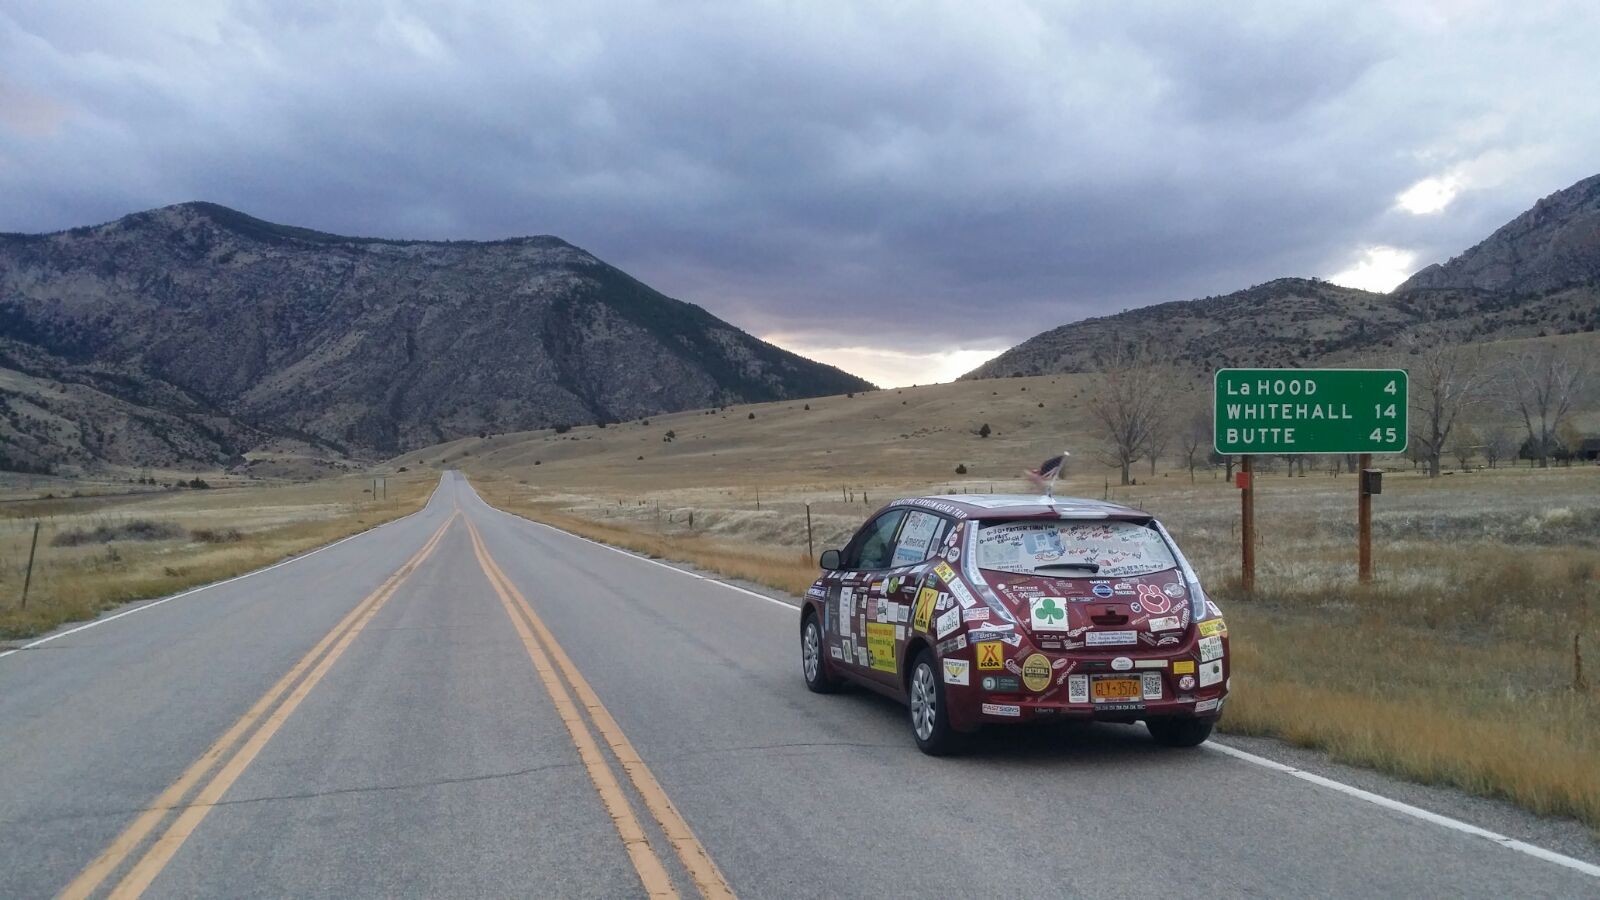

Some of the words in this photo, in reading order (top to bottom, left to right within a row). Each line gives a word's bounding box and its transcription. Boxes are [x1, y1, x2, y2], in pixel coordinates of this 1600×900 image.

[1227, 380, 1250, 395] La
[1257, 380, 1317, 395] HOOD
[1384, 380, 1397, 395] 4
[1227, 404, 1353, 419] WHITEHALL
[1375, 404, 1397, 419] 14
[1227, 428, 1296, 444] BUTTE
[1369, 428, 1397, 443] 45
[935, 502, 954, 513] ROAD
[952, 508, 968, 520] TRIP
[983, 704, 1019, 713] FASTSIGNS
